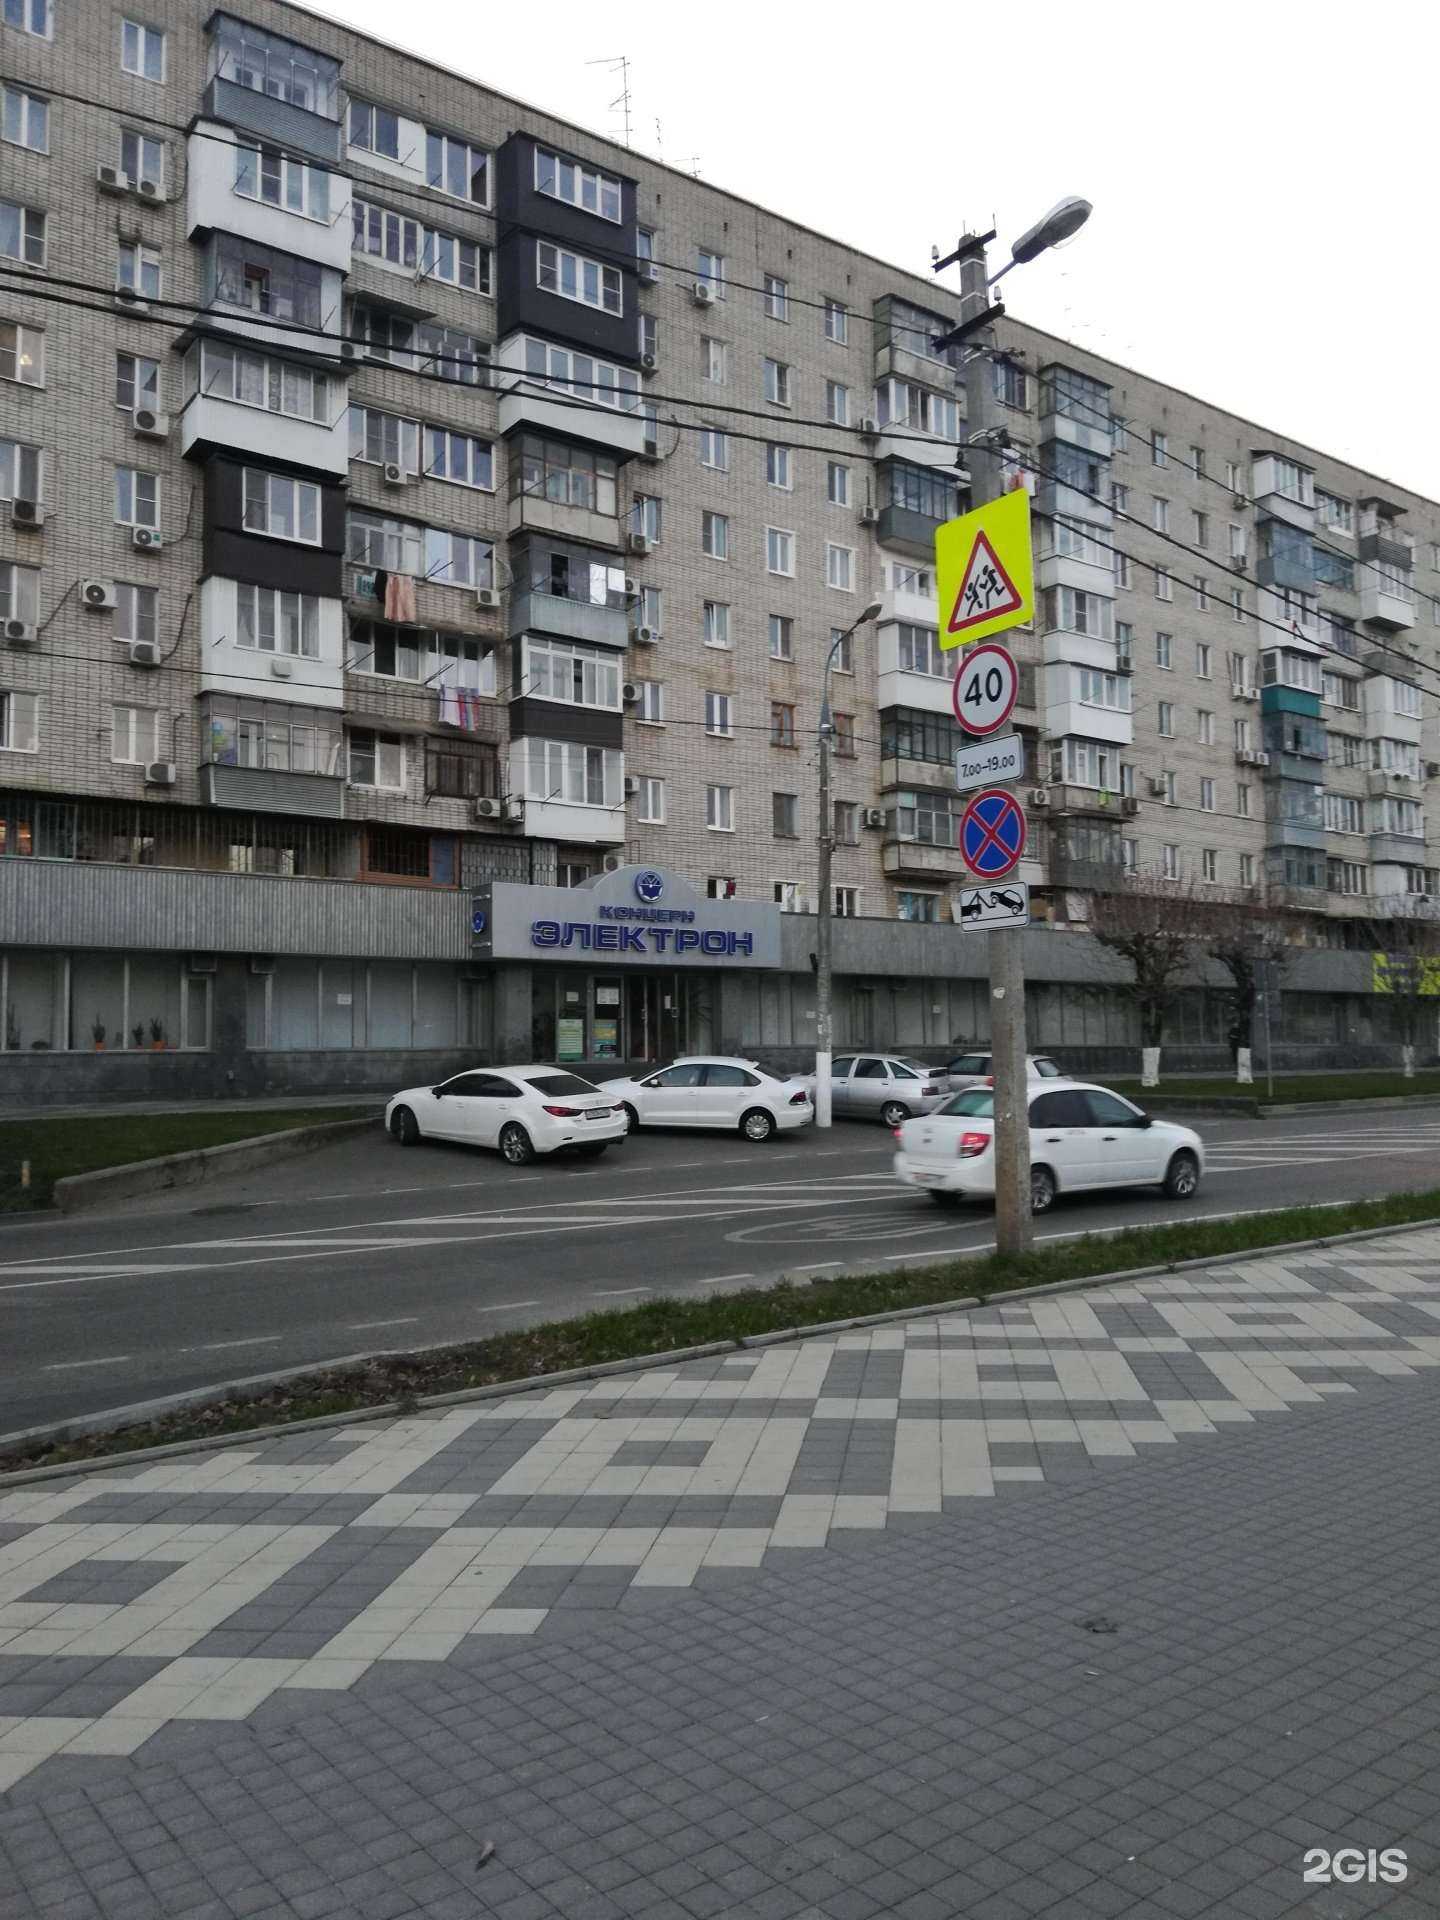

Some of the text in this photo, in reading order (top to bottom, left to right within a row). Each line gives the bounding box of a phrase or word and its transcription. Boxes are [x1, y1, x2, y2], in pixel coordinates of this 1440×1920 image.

[964, 667, 1003, 706] 40
[598, 904, 696, 923] КОНЦЕРН
[531, 920, 754, 955] ЭЛЕКТРОН
